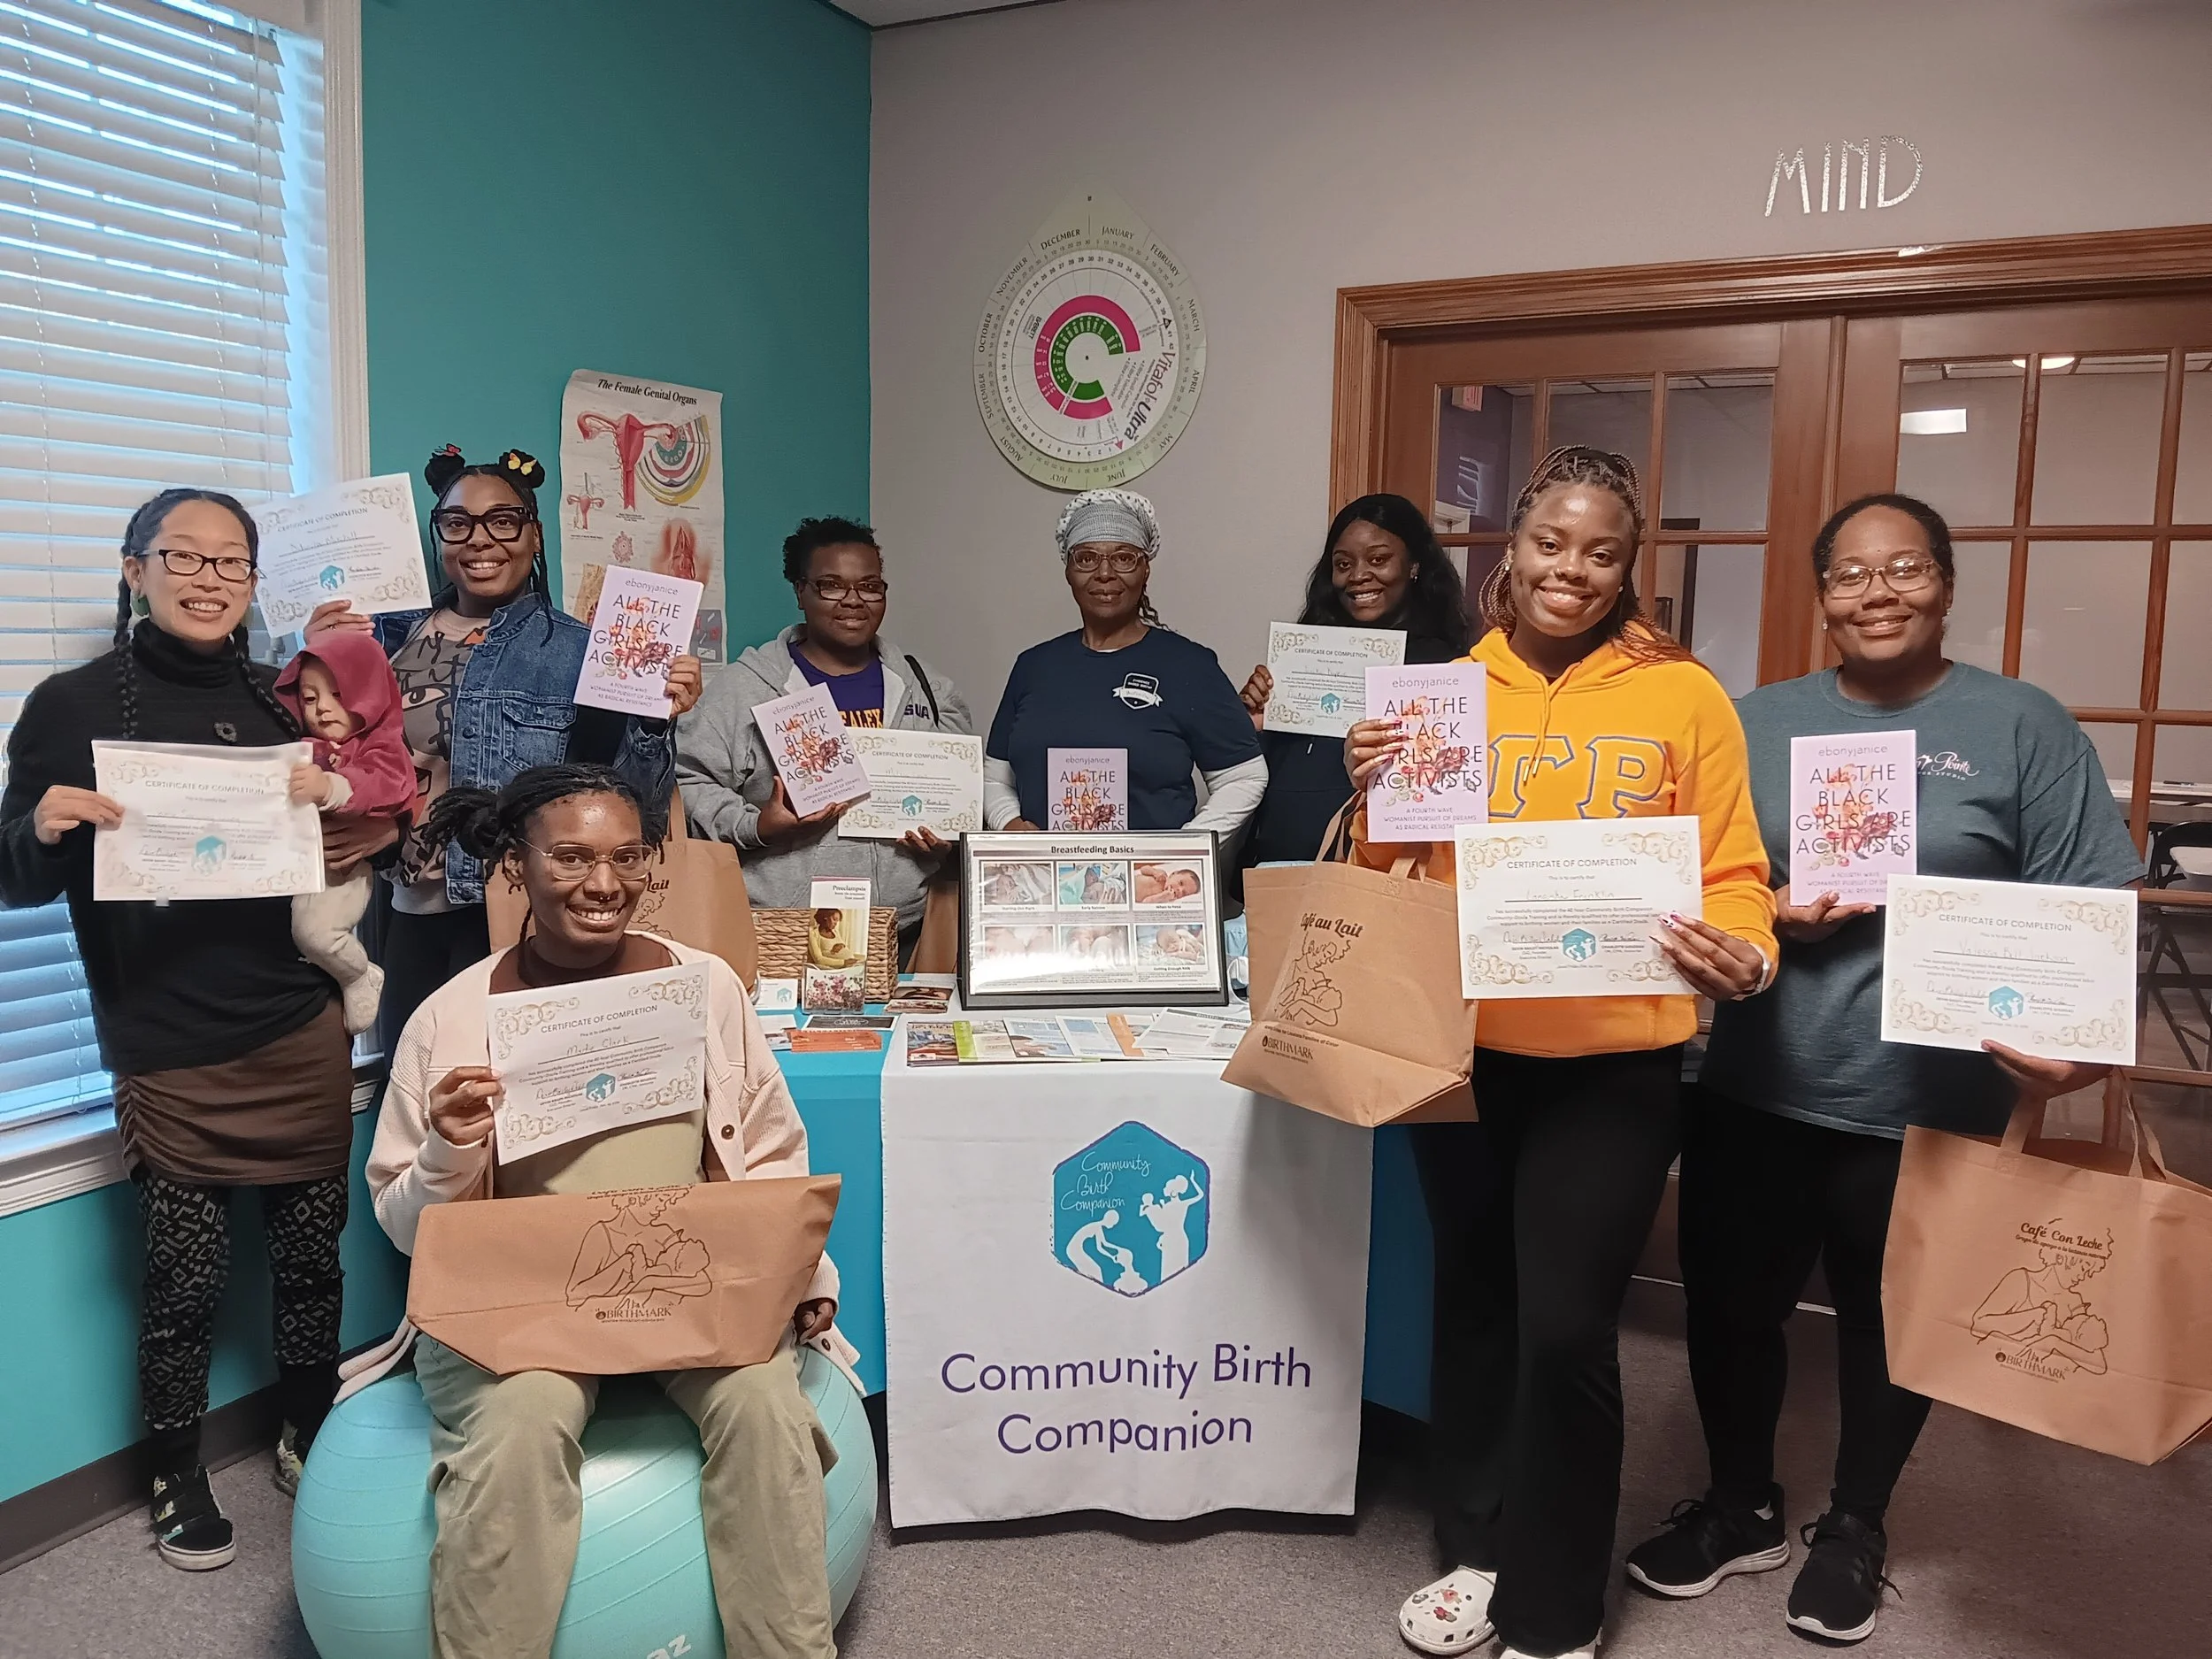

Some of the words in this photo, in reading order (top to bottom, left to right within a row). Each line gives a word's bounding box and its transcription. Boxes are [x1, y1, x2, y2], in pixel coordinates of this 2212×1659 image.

[1764, 134, 1924, 217] MIND
[1041, 229, 1080, 250] DECEMBER
[1102, 226, 1134, 239] JANUARY
[1150, 244, 1180, 276] FEBRUARY
[996, 257, 1028, 296] NOVEMBER
[1187, 299, 1200, 332] MARCH
[978, 313, 993, 353] OCTOBER
[597, 378, 613, 390] The
[614, 381, 643, 396] Female
[644, 386, 672, 401] Genital
[672, 392, 697, 406] Organs
[1188, 369, 1201, 394] APRIL
[979, 373, 994, 419] SEPTEMBER
[1000, 436, 1024, 462] AUGUST
[1159, 433, 1174, 451] MAY
[1050, 473, 1068, 484] JULY
[1108, 469, 1125, 483] JUNE
[625, 577, 679, 595] ebonyjanice
[613, 594, 644, 612] ALL
[651, 600, 681, 619] THE
[615, 614, 670, 637] BLACK
[594, 630, 643, 652] GIRLS
[1392, 677, 1459, 689] ebonyjanice
[1384, 699, 1421, 717] ALL
[1429, 697, 1468, 714] THE
[774, 717, 799, 734] ALL
[801, 706, 828, 725] THE
[784, 723, 830, 747] BLACK
[778, 744, 818, 767] GIRLS
[823, 733, 849, 753] ARE
[1066, 755, 1110, 765] ebonyjanice
[1443, 745, 1482, 763] ARE
[1818, 745, 1888, 758] ebonyjanice
[786, 748, 855, 783] ACTIVISTS
[1809, 768, 1849, 784] ALL
[1856, 764, 1897, 782] THE
[1931, 751, 1980, 776] Pointe
[1060, 771, 1085, 783] ALL
[1090, 771, 1116, 783] THE
[1373, 770, 1482, 790] ACTIVISTS
[1936, 772, 1966, 781] STUDIO
[146, 780, 195, 790] CERTIFICATE
[211, 785, 264, 795] COMPLETION
[1066, 787, 1111, 799] BLACK
[1818, 788, 1889, 807] BLACK
[1051, 803, 1092, 815] GIRLS
[1098, 803, 1125, 815] ARE
[1052, 820, 1125, 830] ACTIVISTS
[1796, 812, 1860, 831] GIRLS
[1869, 810, 1911, 828] ARE
[1051, 845, 1107, 855] Breastfeeding
[1109, 845, 1135, 854] Basics
[1796, 834, 1911, 855] ACTIVISTS
[1507, 860, 1561, 868] CERTIFICATE
[1577, 858, 1637, 867] COMPLETION
[1315, 918, 1332, 930] au
[1335, 918, 1363, 938] Lait
[1939, 914, 1993, 926] CERTIFICATE
[2011, 920, 2072, 931] COMPLETION
[541, 1018, 592, 1033] CERTIFICATE
[593, 1015, 605, 1024] OF
[607, 1005, 657, 1021] COMPLETION
[1268, 1037, 1313, 1060] BIRTHMARK
[1081, 1151, 1152, 1178] Community
[1076, 1171, 1114, 1197] Birth
[1060, 1190, 1125, 1218] Companion
[2020, 1222, 2048, 1239] Café
[2051, 1230, 2074, 1244] Con
[2077, 1236, 2103, 1250] Leche
[607, 1307, 672, 1318] BIRTHMARK
[941, 1350, 1198, 1400] Community
[1214, 1343, 1310, 1389] Birth
[2005, 1354, 2066, 1380] BIRTHMARK
[998, 1410, 1252, 1454] Companion
